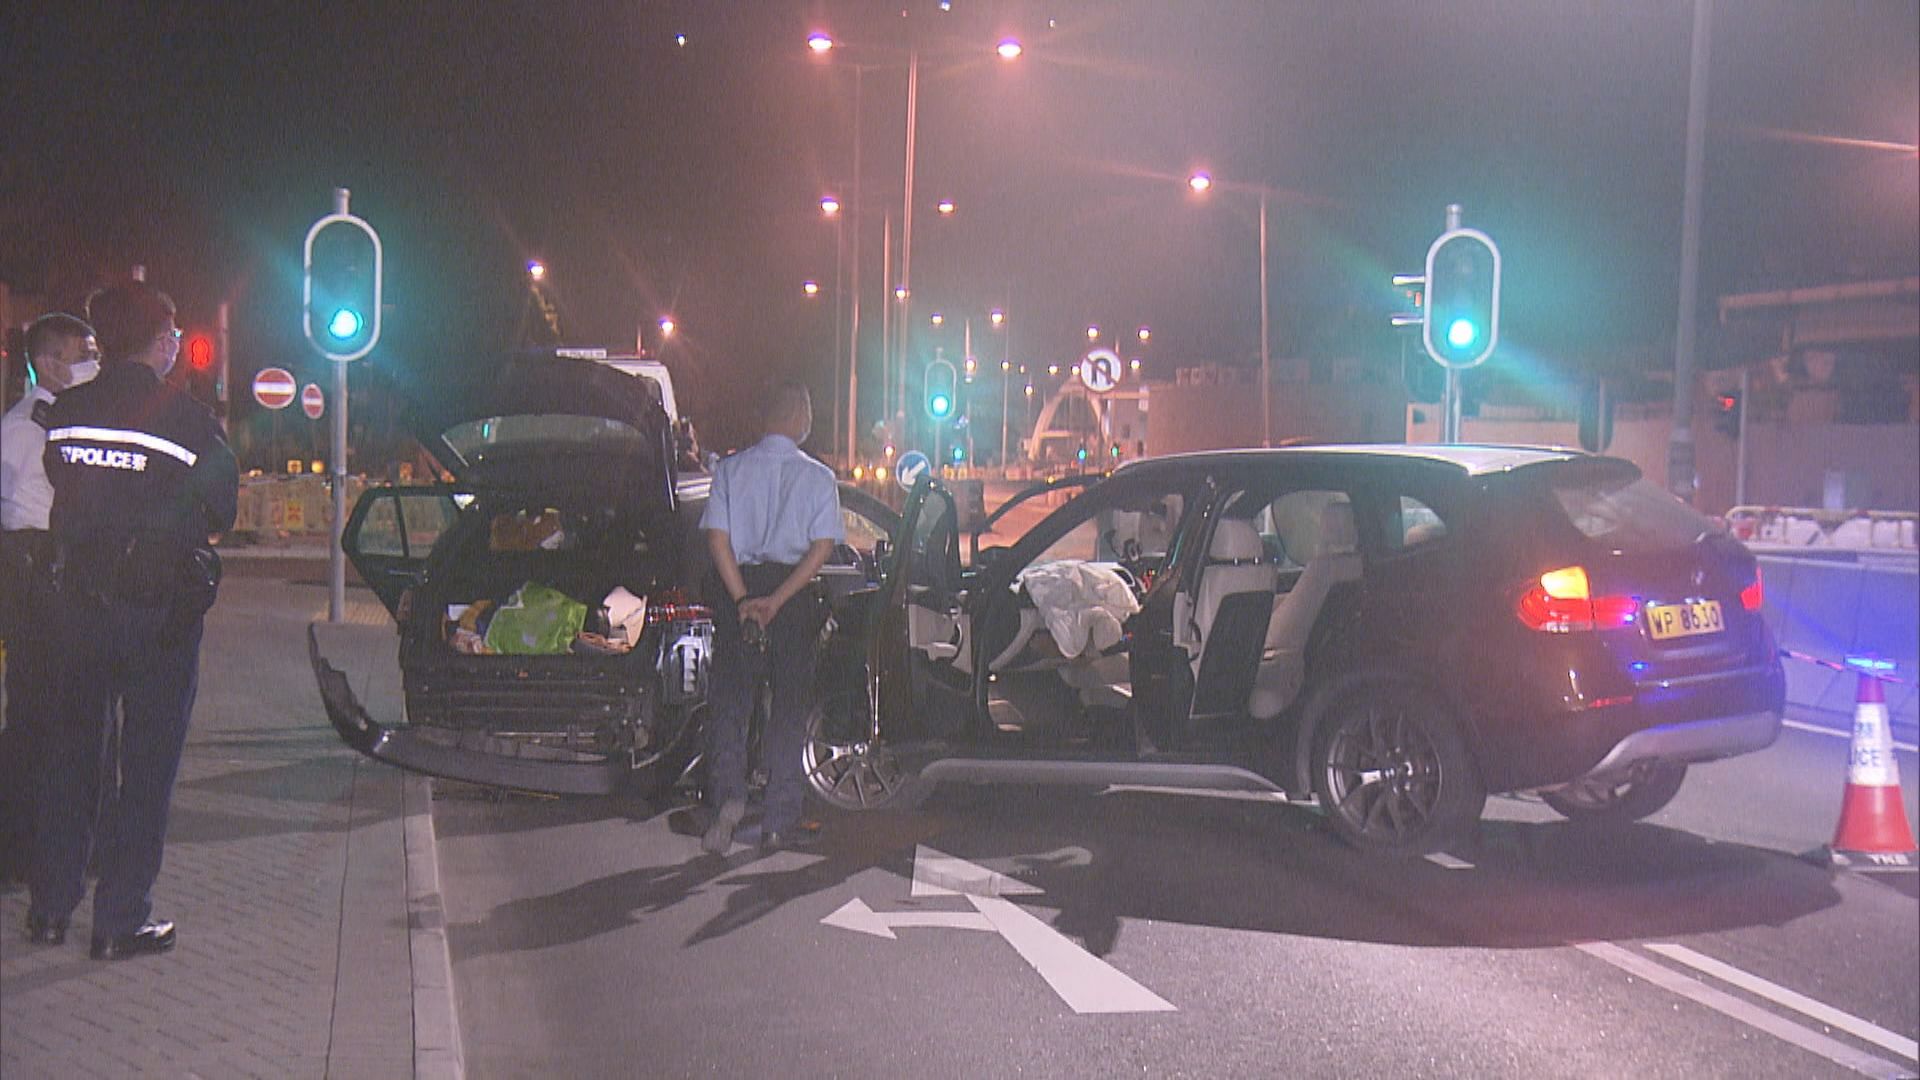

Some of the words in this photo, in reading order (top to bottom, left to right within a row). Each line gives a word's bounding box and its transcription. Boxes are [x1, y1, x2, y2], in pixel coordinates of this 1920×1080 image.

[70, 447, 132, 469] POLICE
[1651, 608, 1673, 634] WP
[1680, 604, 1719, 631] 8630
